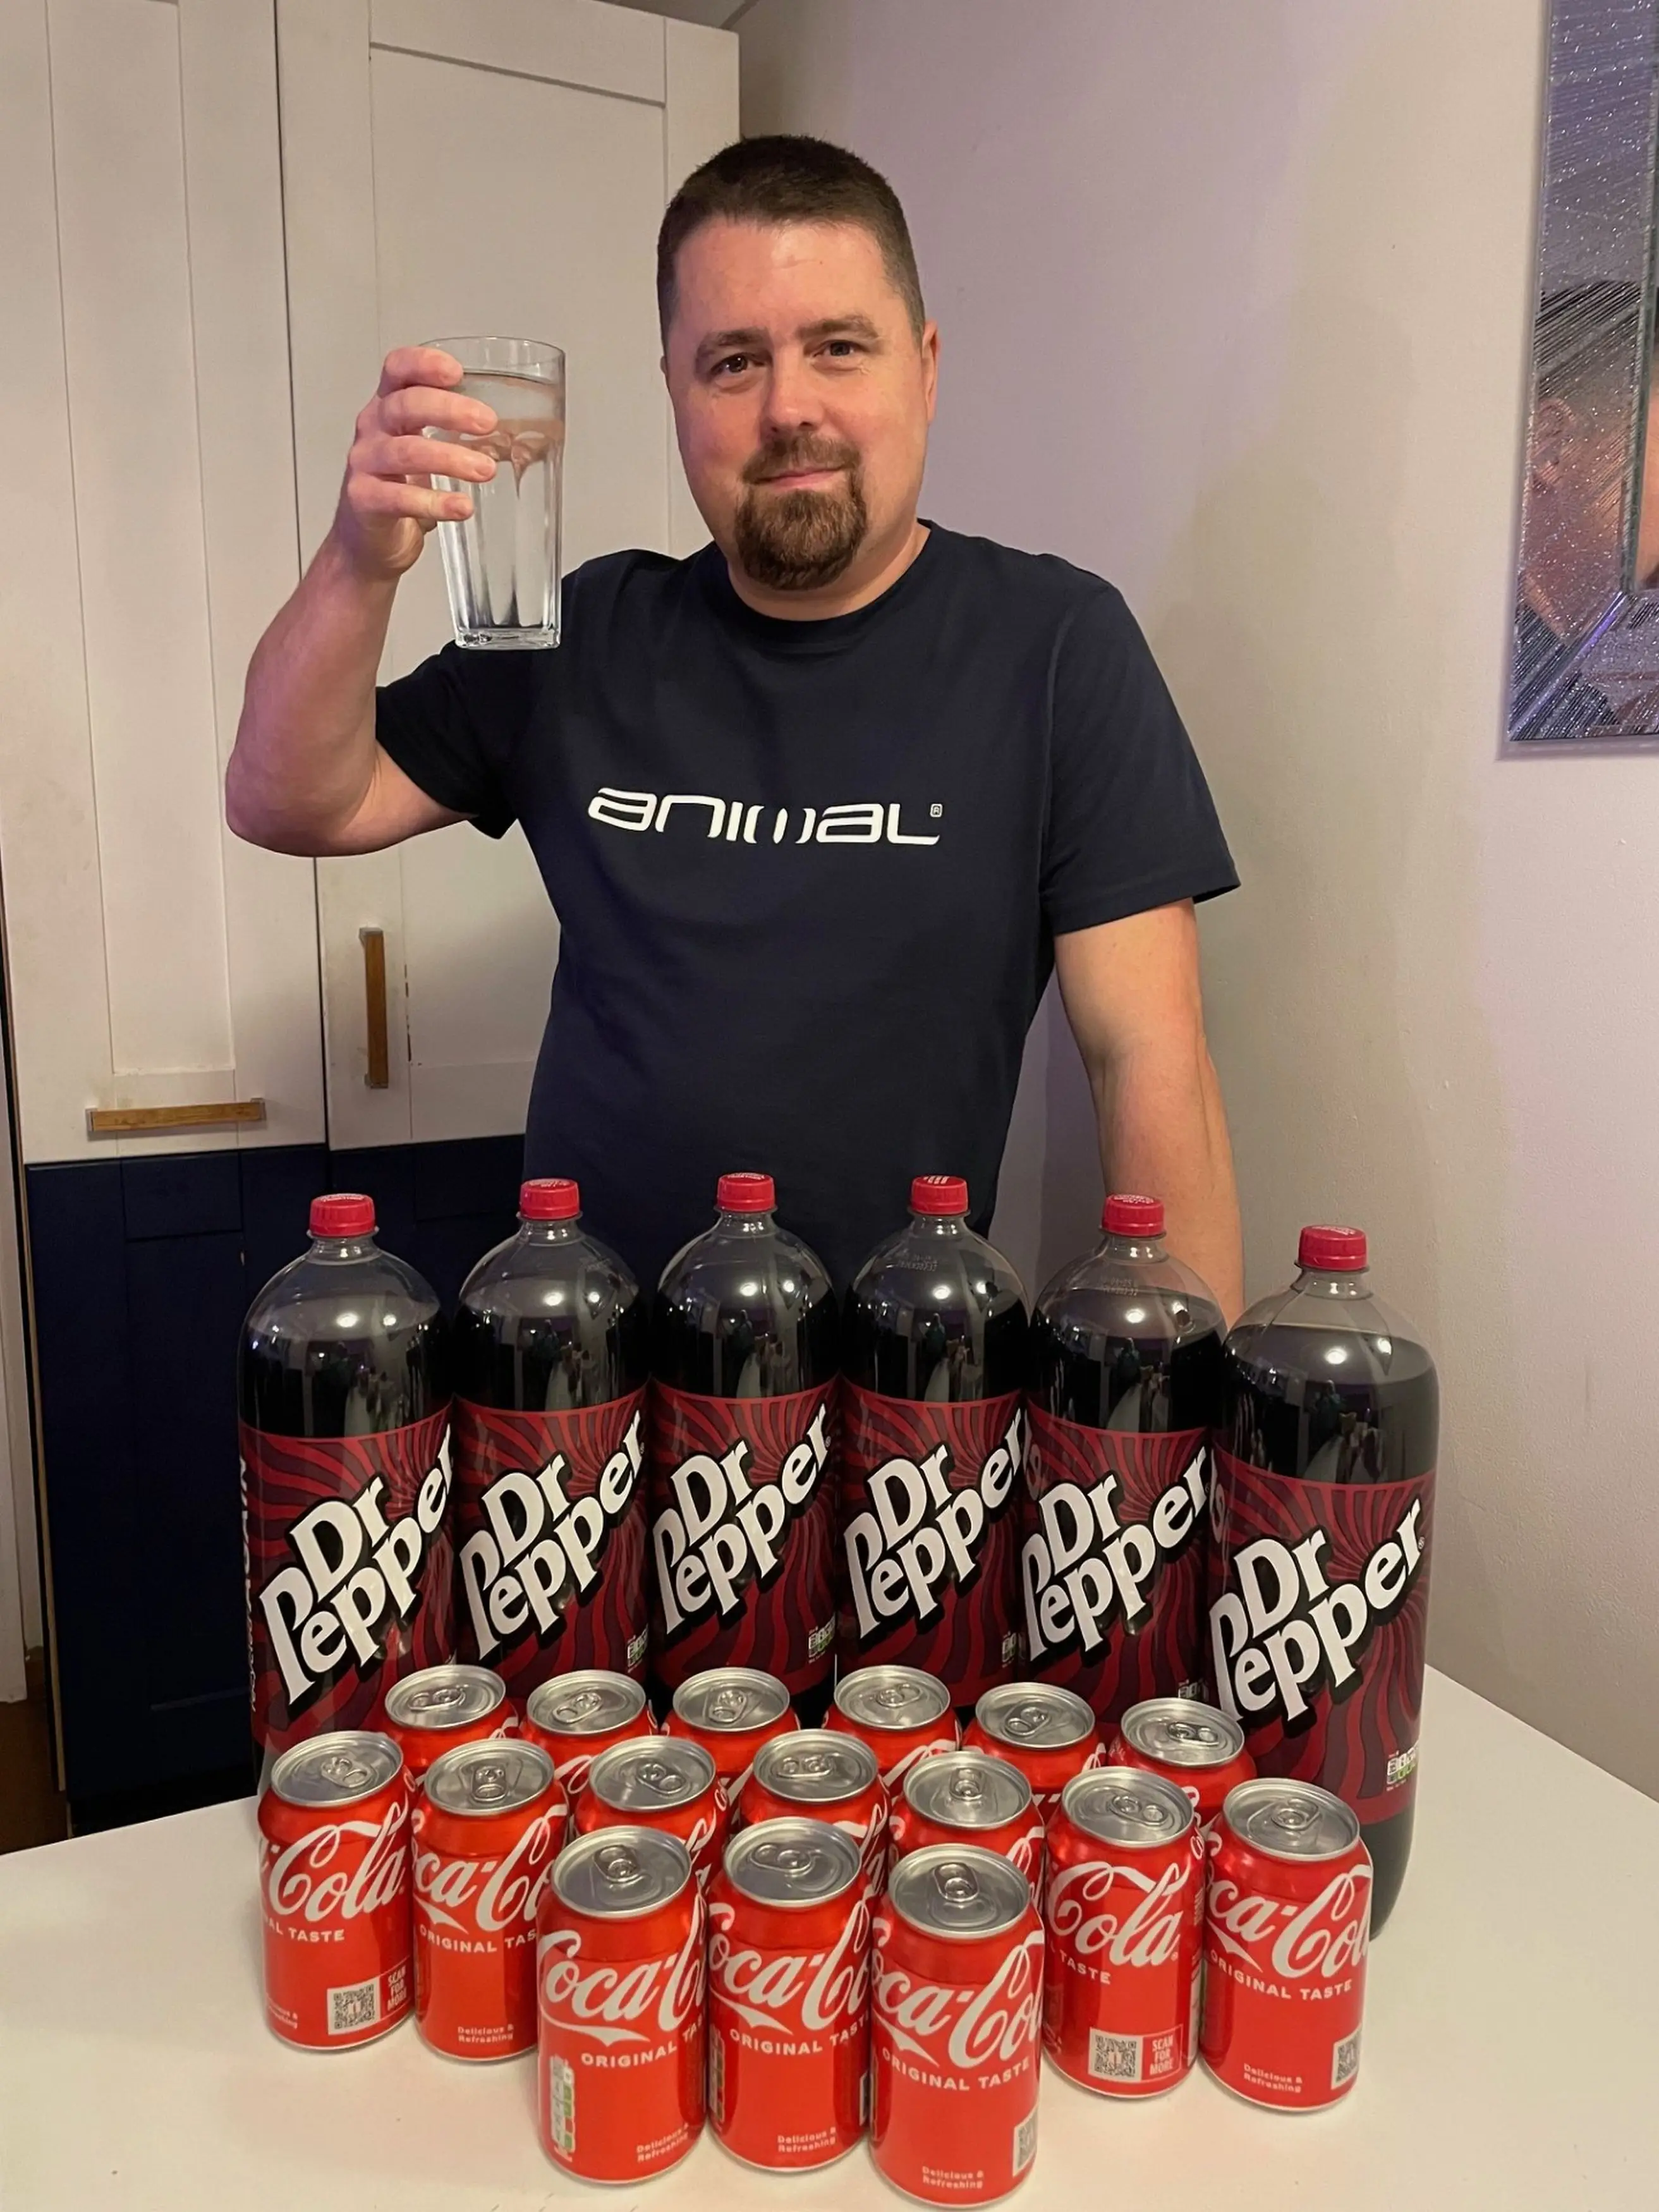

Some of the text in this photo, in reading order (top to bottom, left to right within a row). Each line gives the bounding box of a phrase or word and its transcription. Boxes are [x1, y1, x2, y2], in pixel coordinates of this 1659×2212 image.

[482, 1454, 570, 1567] Dr
[671, 1440, 752, 1547] Dr
[868, 1445, 952, 1550] Dr
[290, 1477, 389, 1602] Dr
[460, 1411, 642, 1659] Pepper
[654, 1404, 828, 1635] Pepper
[844, 1409, 1021, 1639] Pepper
[1039, 1474, 1121, 1575] Dr
[259, 1424, 453, 1705] Pepper
[1022, 1447, 1206, 1663] Pepper
[1234, 1529, 1329, 1638] Dr
[1210, 1499, 1421, 1722] Pepper
[289, 1927, 344, 1942] TASTE
[420, 1924, 536, 1952] ORIGINAL TAS
[1060, 1949, 1111, 1984] TASTE
[1211, 1949, 1352, 2000] ORIGINAL TASTE
[581, 2041, 677, 2068] ORIGINAL
[730, 2014, 868, 2056] ORIGINAL TAST
[1152, 2034, 1174, 2052] SCAN
[1155, 2049, 1171, 2063] FOR
[883, 2047, 1030, 2091] ORIGINAL TASTE
[1150, 2060, 1174, 2075] MORE
[1244, 2063, 1292, 2083] Delicious
[777, 2130, 827, 2144] Delicious
[922, 2166, 973, 2179] Delicious
